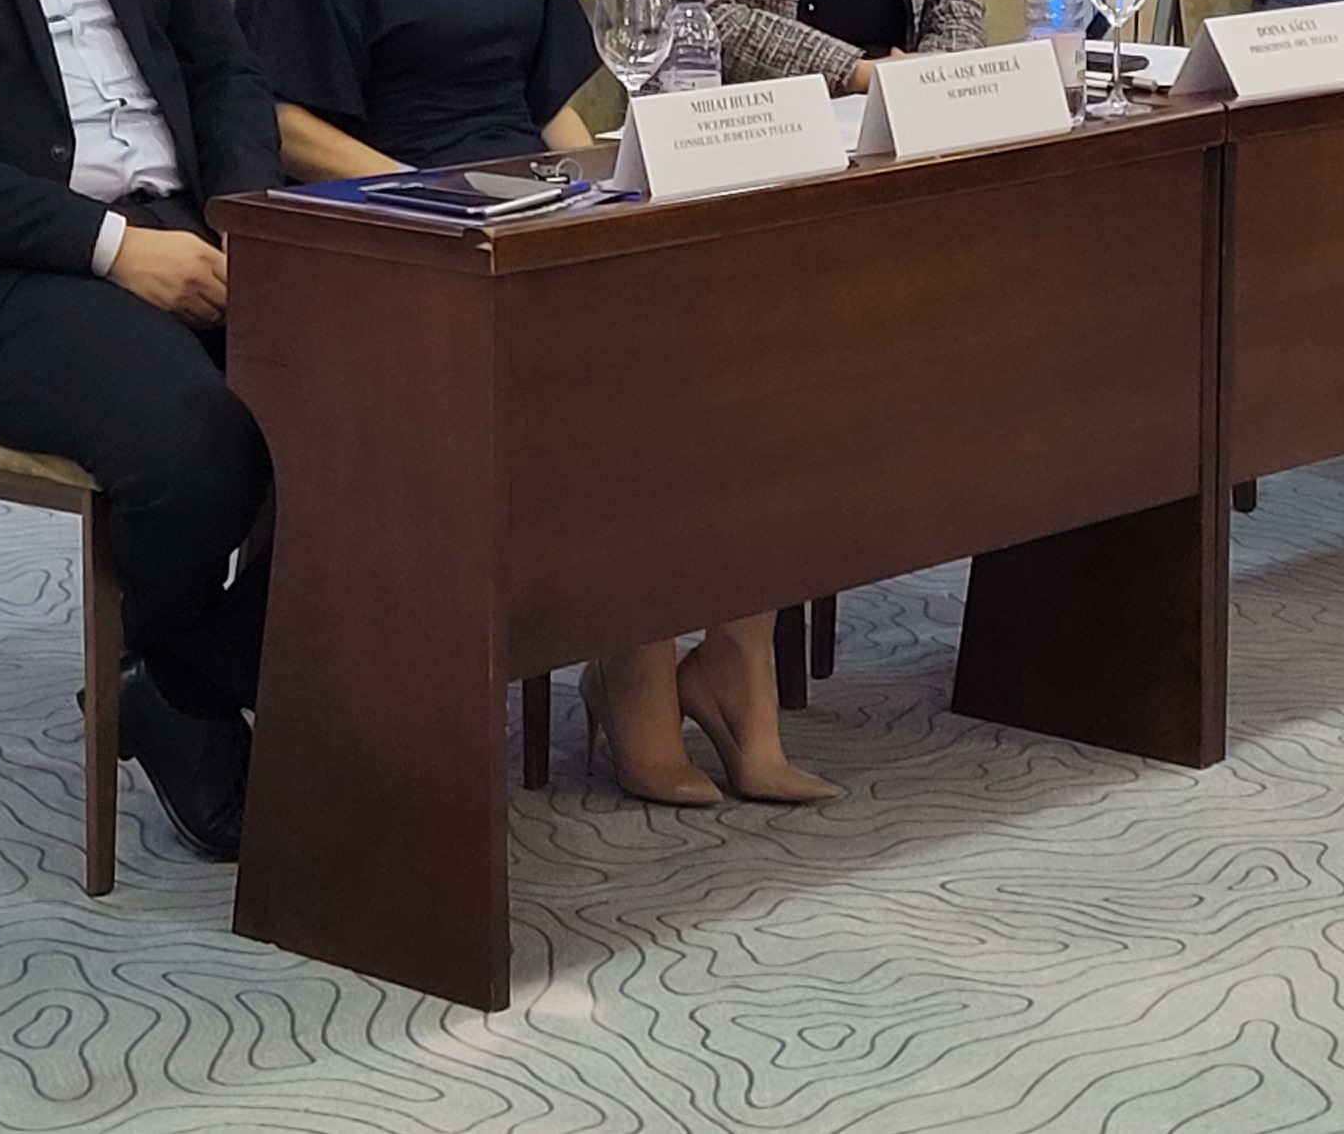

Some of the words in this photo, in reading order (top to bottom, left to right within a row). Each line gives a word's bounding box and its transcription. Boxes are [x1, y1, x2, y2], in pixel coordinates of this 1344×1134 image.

[690, 96, 728, 114] MIHAI
[729, 91, 774, 110] HULENI
[947, 83, 999, 99] SUBPREFECT
[674, 134, 721, 150] CONSILIUL
[768, 122, 803, 136] TULCEA
